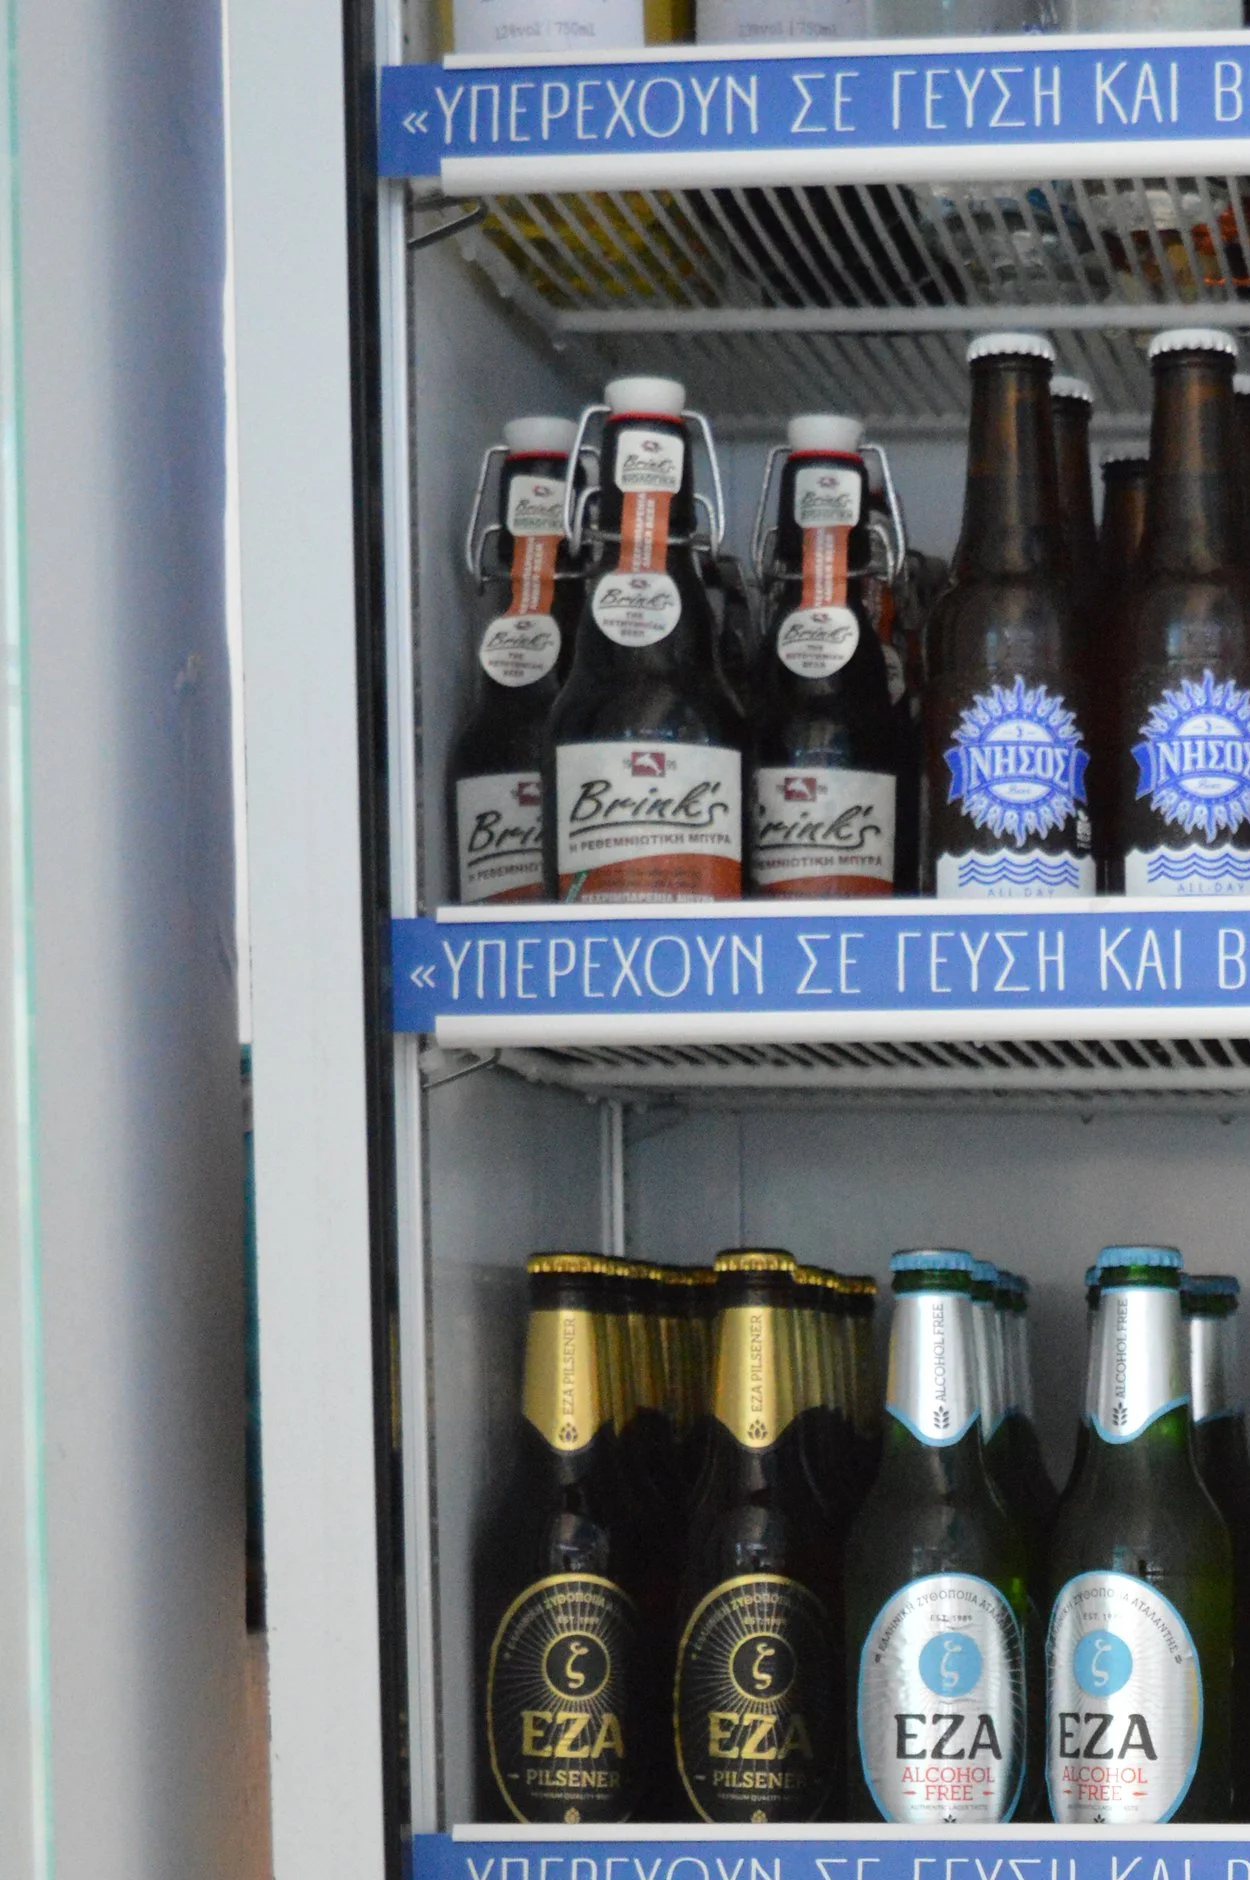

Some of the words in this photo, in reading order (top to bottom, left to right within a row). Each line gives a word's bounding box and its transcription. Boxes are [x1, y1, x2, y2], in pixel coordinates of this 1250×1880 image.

[402, 75, 758, 145] «ΥΠΕΡΕΧΟΥΝ
[791, 72, 859, 133] ΣΕ
[893, 66, 1062, 131] ΓΕΥΣΗ
[1096, 61, 1178, 125] ΚΑΙ
[968, 744, 1070, 790] ΝΗΣΟΣ
[569, 779, 730, 838] Brink's
[410, 934, 764, 1000] «ΥΠΕΡΕΧΟΥΝ
[796, 933, 861, 995] ΣΕ
[897, 930, 1065, 994] ΓΕΥΣΗ
[1101, 927, 1182, 991] ΚΑΙ
[932, 1302, 945, 1332] FREE
[932, 1333, 947, 1402] ALCOHOL
[520, 1710, 626, 1759] EZA
[706, 1710, 814, 1759] EZA
[893, 1712, 1003, 1760] EZA
[1058, 1712, 1158, 1760] EZA
[901, 1765, 996, 1785] ALCOHOL
[925, 1784, 974, 1802] FREE
[1062, 1764, 1149, 1785] ALCOHOL
[1077, 1784, 1123, 1802] FREE
